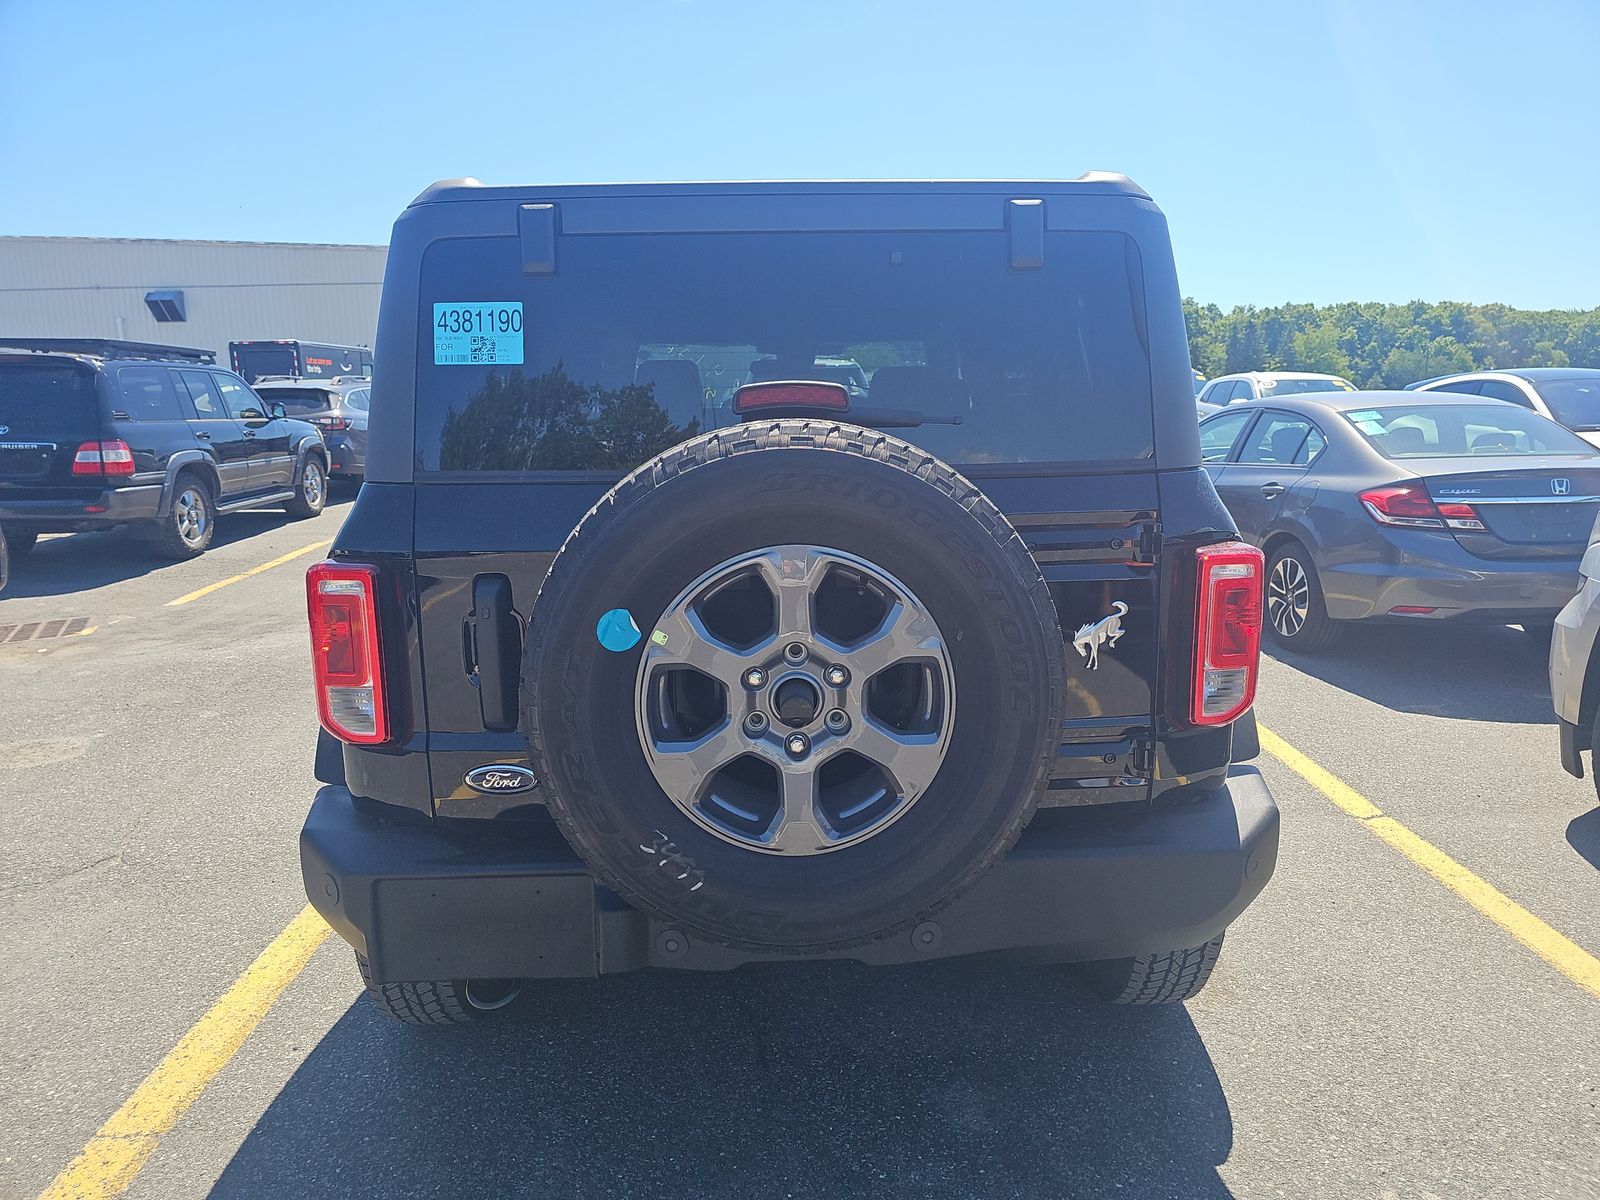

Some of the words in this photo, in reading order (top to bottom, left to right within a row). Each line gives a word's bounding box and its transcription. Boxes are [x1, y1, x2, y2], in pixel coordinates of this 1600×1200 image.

[437, 309, 523, 333] 4381190
[436, 343, 454, 351] FOR
[757, 469, 1036, 718] BRIDGESTONE
[482, 771, 522, 788] Ford
